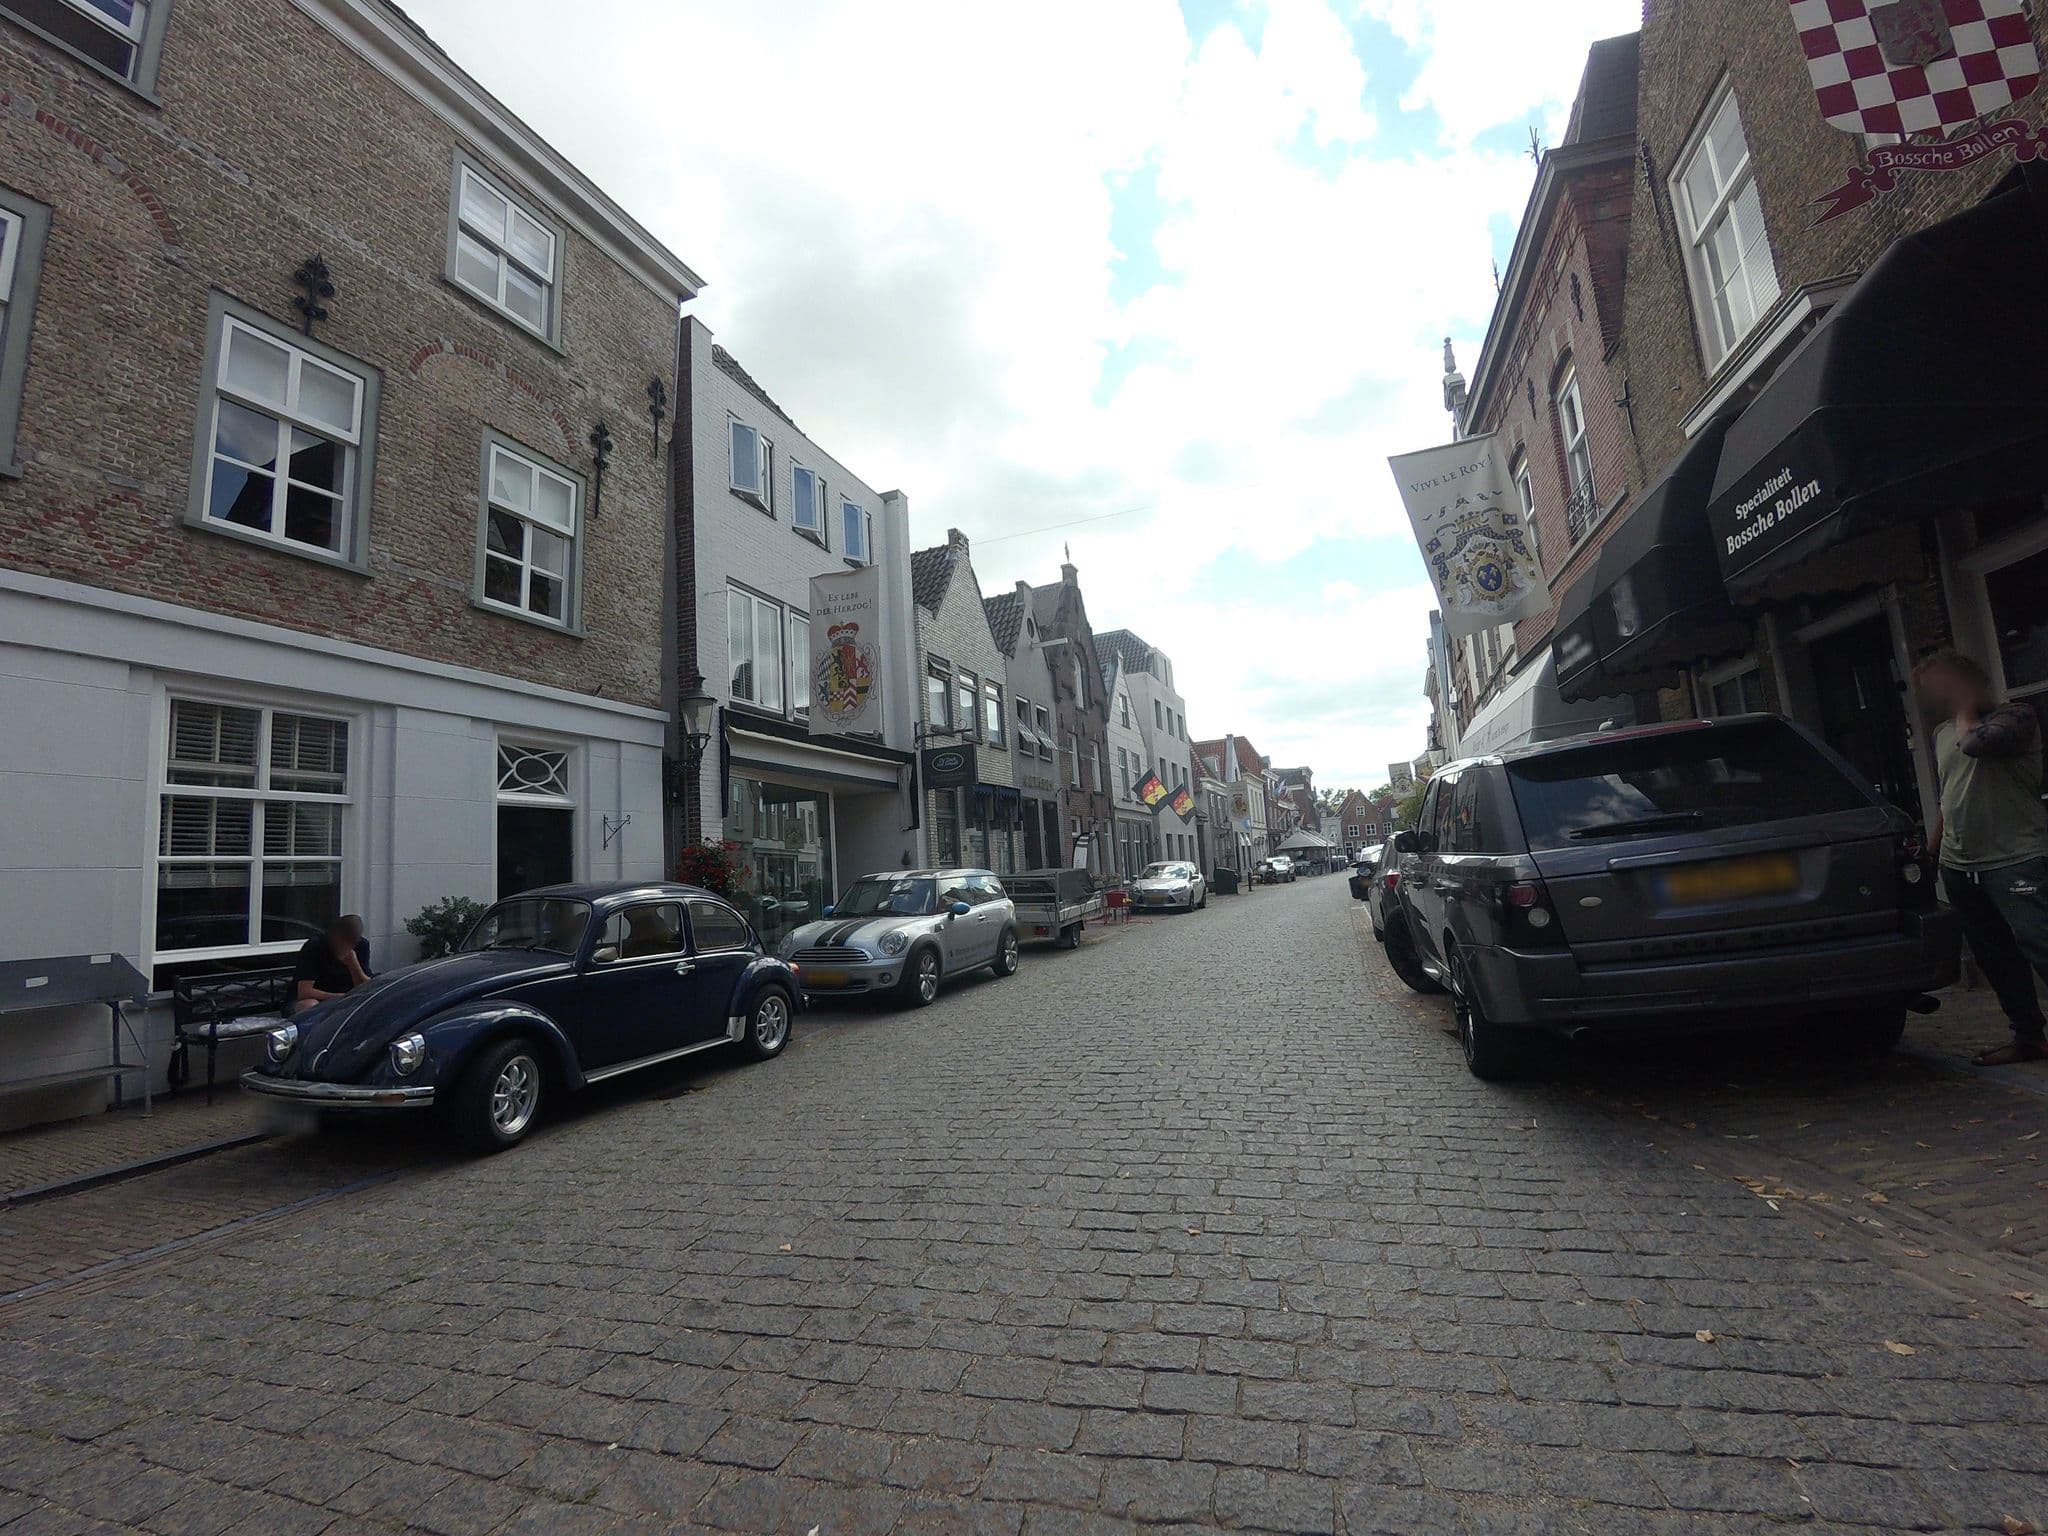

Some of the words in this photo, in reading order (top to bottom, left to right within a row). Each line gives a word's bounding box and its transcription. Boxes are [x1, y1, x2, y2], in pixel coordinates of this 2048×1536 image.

[1875, 148, 1954, 168] Bossche
[1956, 126, 2021, 161] Bollen
[1726, 511, 1775, 555] Bossche
[1775, 479, 1821, 521] Bollen
[1735, 466, 1793, 520] Specialiteit
